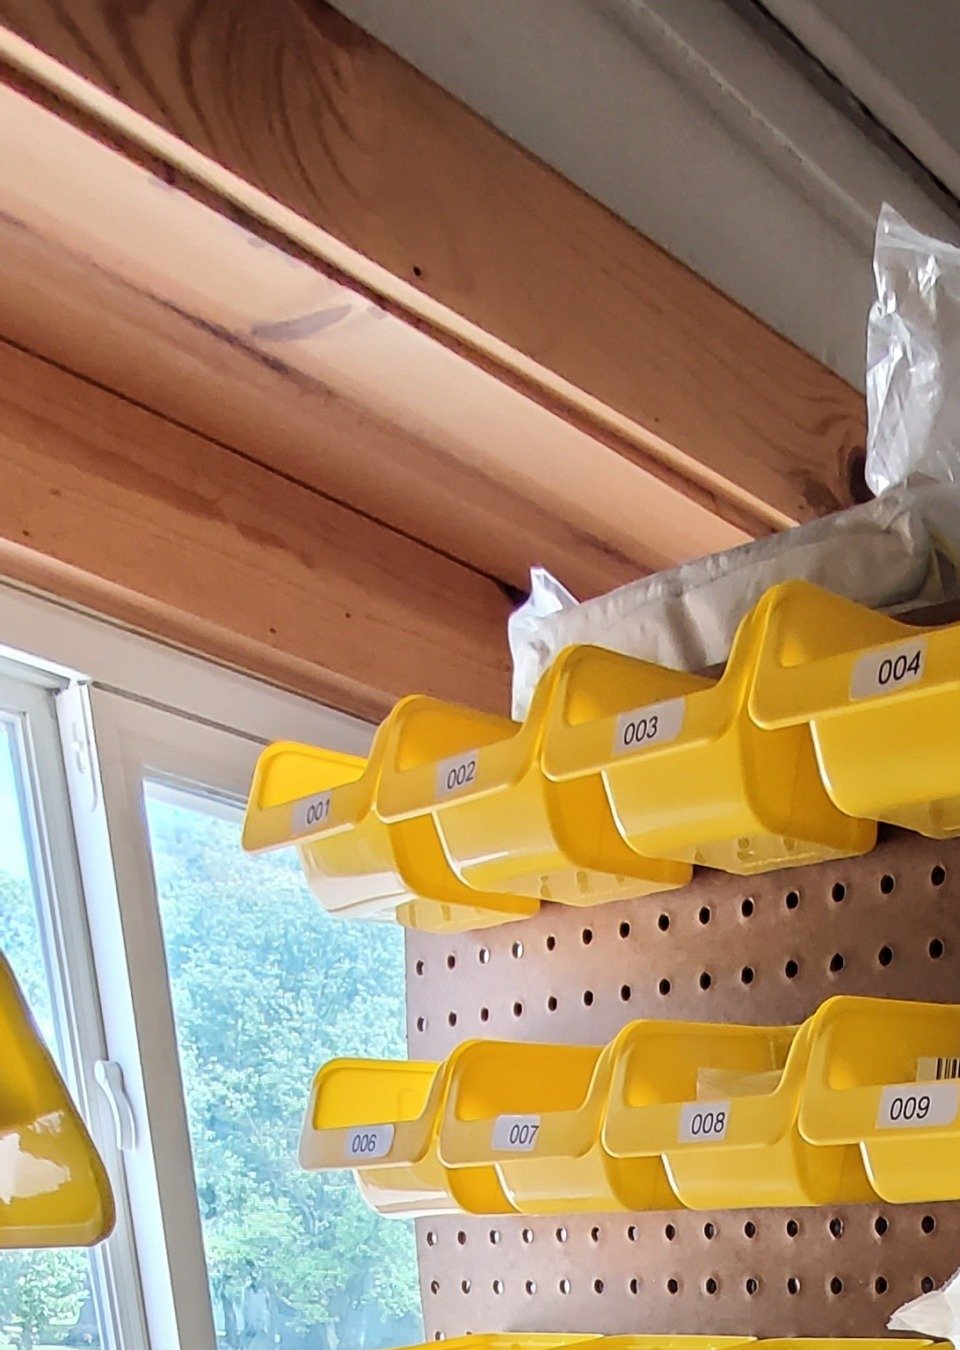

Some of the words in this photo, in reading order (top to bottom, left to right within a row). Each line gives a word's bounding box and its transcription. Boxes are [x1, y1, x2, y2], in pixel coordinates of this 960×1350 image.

[877, 651, 922, 685] 004
[622, 715, 659, 746] 003
[446, 760, 476, 790] 002
[305, 798, 331, 825] 001
[889, 1095, 931, 1121] 009
[509, 1123, 540, 1146] 007
[690, 1111, 726, 1136] 008
[351, 1133, 377, 1154] 006
